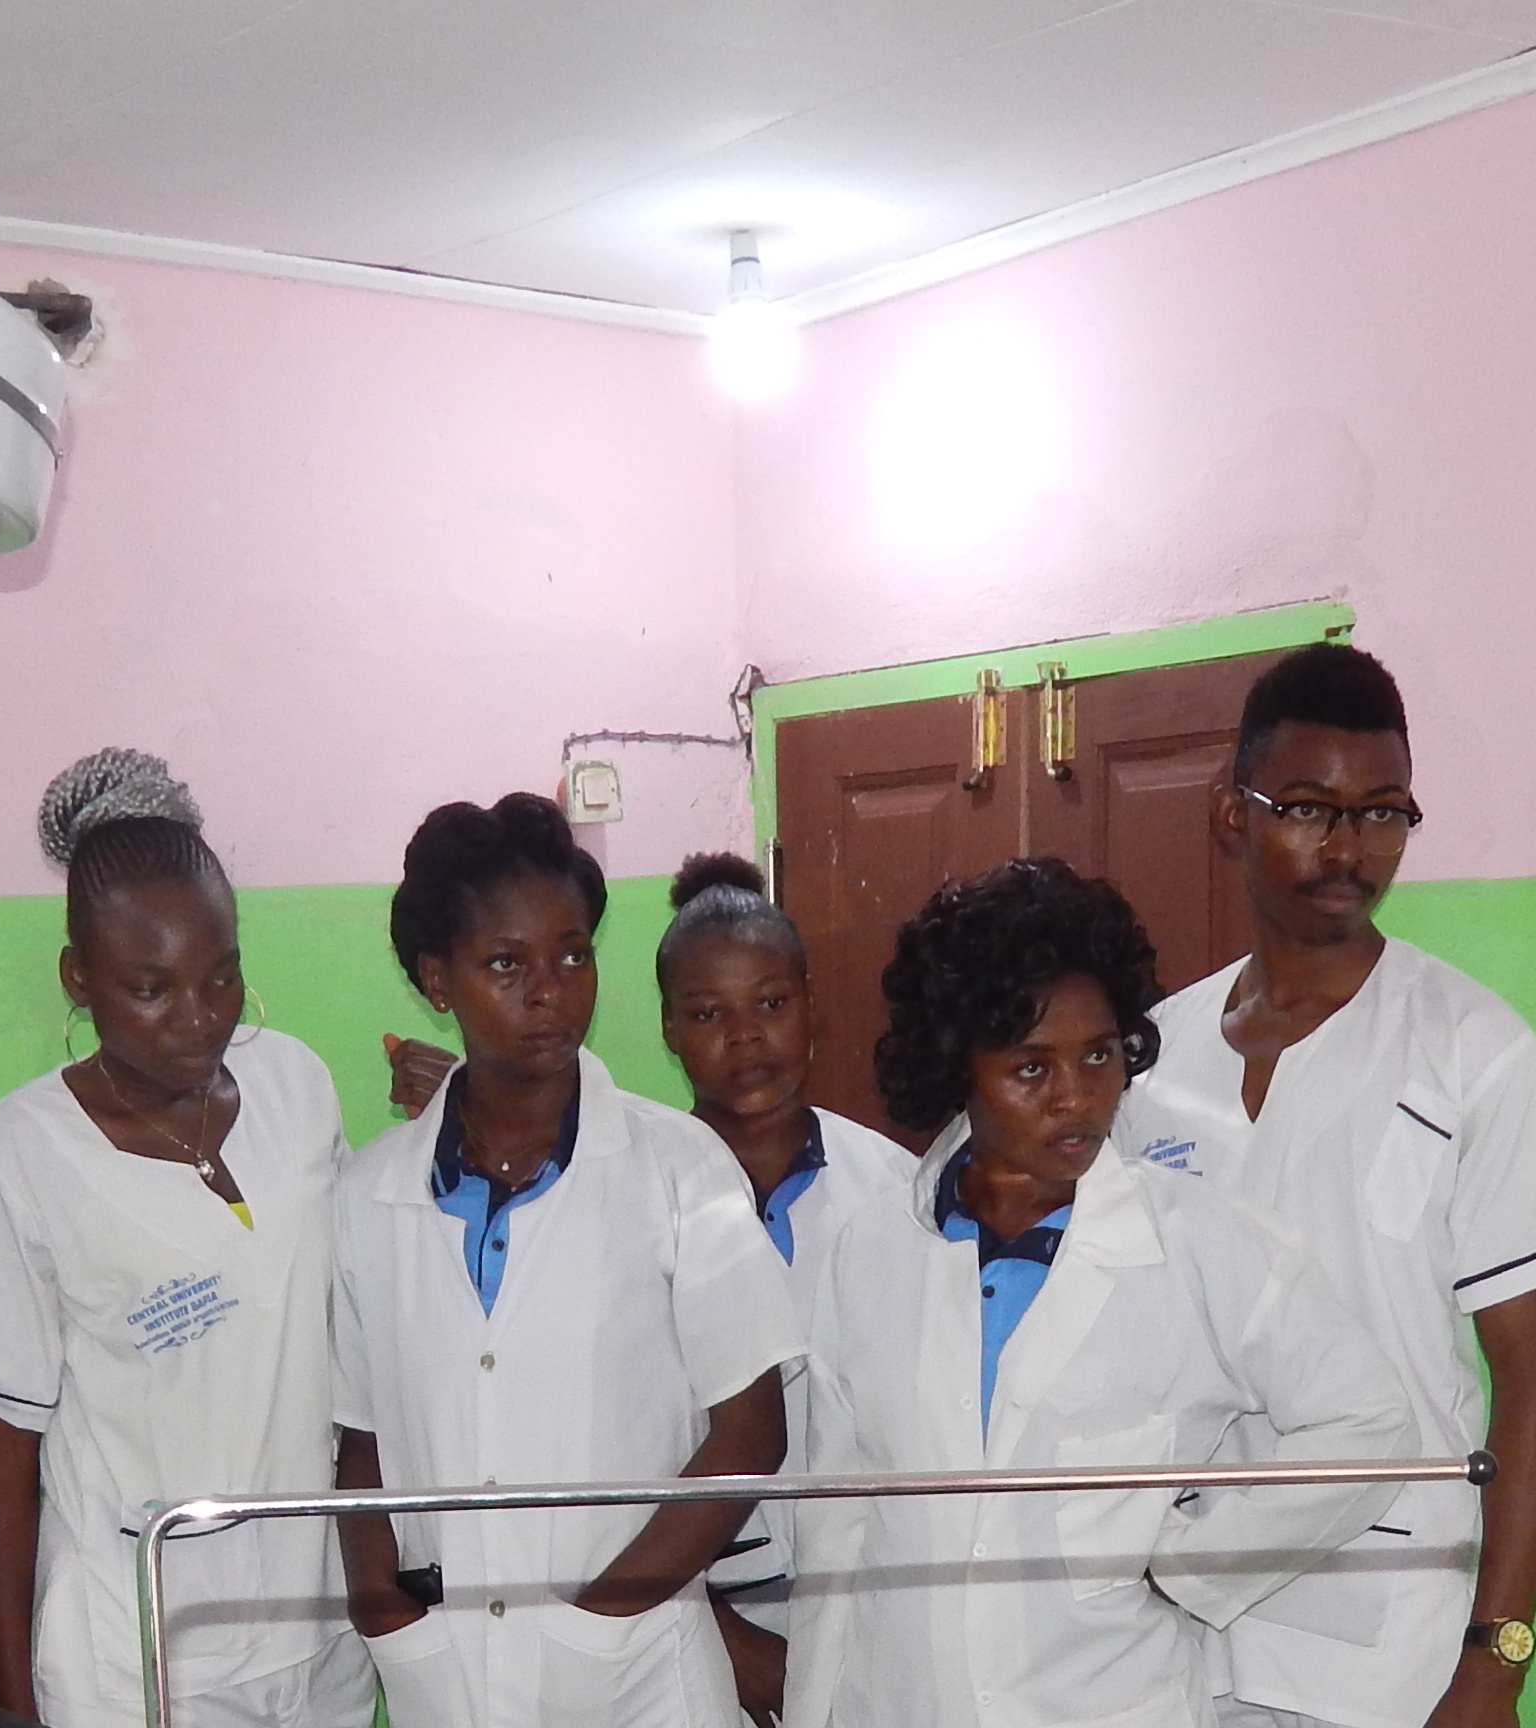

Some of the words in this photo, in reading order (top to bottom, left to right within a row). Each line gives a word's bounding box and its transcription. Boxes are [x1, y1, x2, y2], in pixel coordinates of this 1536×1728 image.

[127, 1299, 170, 1326] CENTRAL
[169, 1274, 221, 1304] UNIVERSITY
[144, 1304, 190, 1332] INSTITUTE
[190, 1291, 218, 1312] BAFIA
